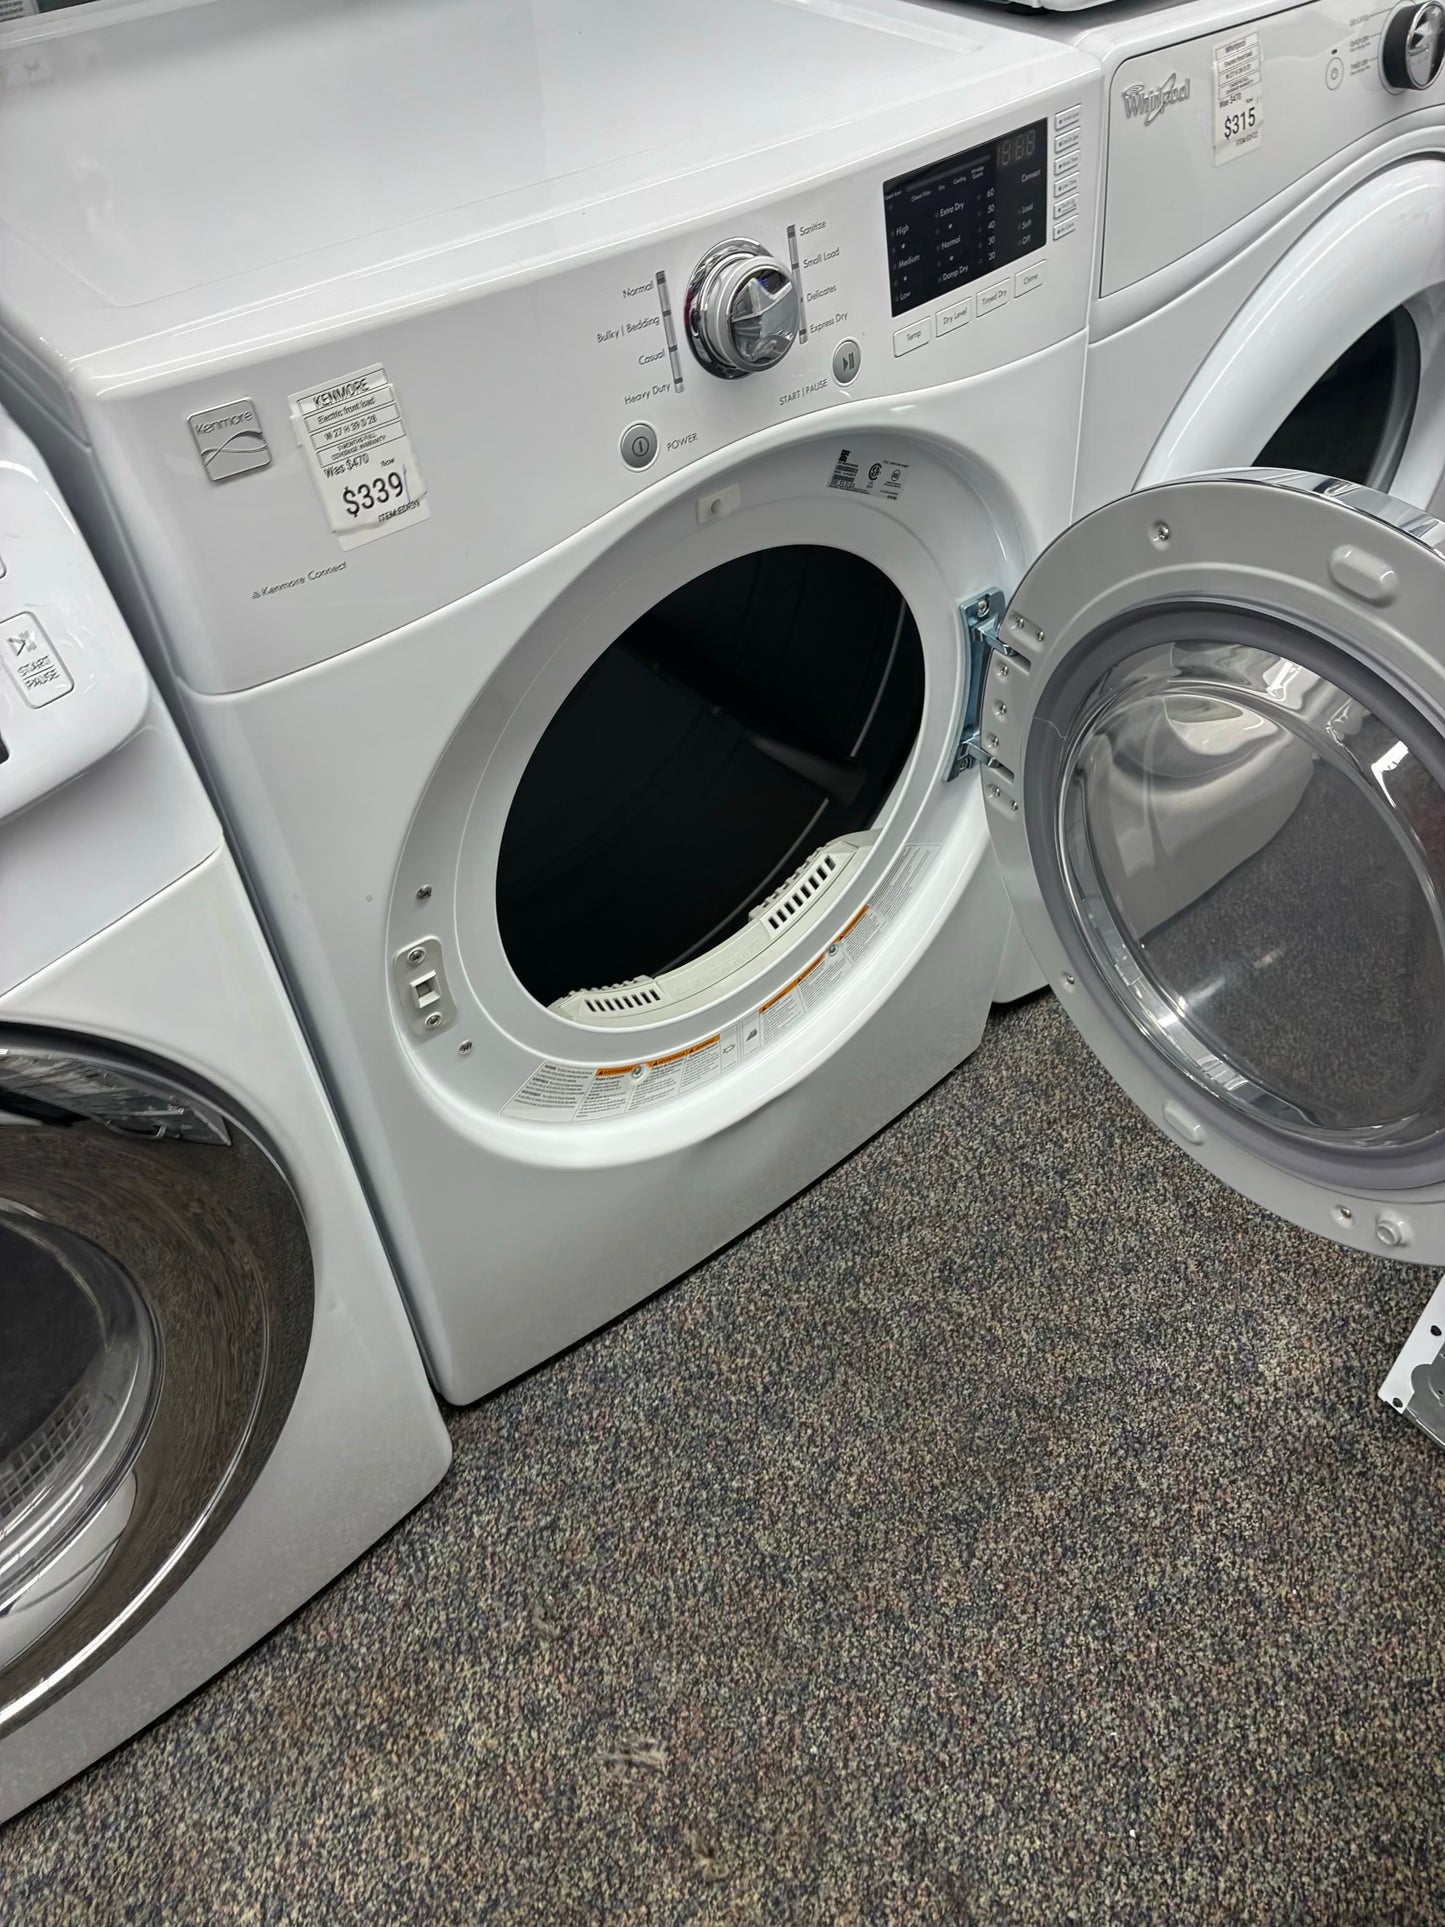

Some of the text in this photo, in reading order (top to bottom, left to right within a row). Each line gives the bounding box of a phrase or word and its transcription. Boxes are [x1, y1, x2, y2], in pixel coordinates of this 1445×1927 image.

[1121, 75, 1191, 123] Whirlpool
[1224, 106, 1256, 140] $315
[986, 188, 996, 198] 60
[954, 201, 965, 214] Dry
[987, 204, 996, 215] 50
[800, 220, 827, 237] Sanitize
[896, 224, 910, 237] High
[941, 235, 961, 250] Normal
[987, 236, 996, 246] 30
[803, 247, 841, 269] Small Load
[898, 254, 921, 269] Medium
[987, 251, 996, 262] 20
[959, 264, 969, 277] Dry
[622, 280, 655, 299] Normal
[807, 284, 838, 303] Delicates
[998, 289, 1008, 299] Dry
[809, 312, 849, 334] Express Dry
[943, 307, 968, 326] Dry Level
[597, 316, 661, 344] Bulky Bedding
[638, 348, 666, 366] Casual
[312, 377, 371, 410] KENMORE
[624, 382, 671, 405] Heavy Duty
[779, 378, 829, 406] START PAUSE
[194, 409, 255, 436] Kenmore
[667, 432, 699, 452] POWER
[323, 452, 370, 479] Was $470
[342, 471, 404, 519] $339
[261, 561, 348, 598] Kenmore Connect
[17, 655, 51, 678] START
[24, 668, 61, 691] PAUSE
